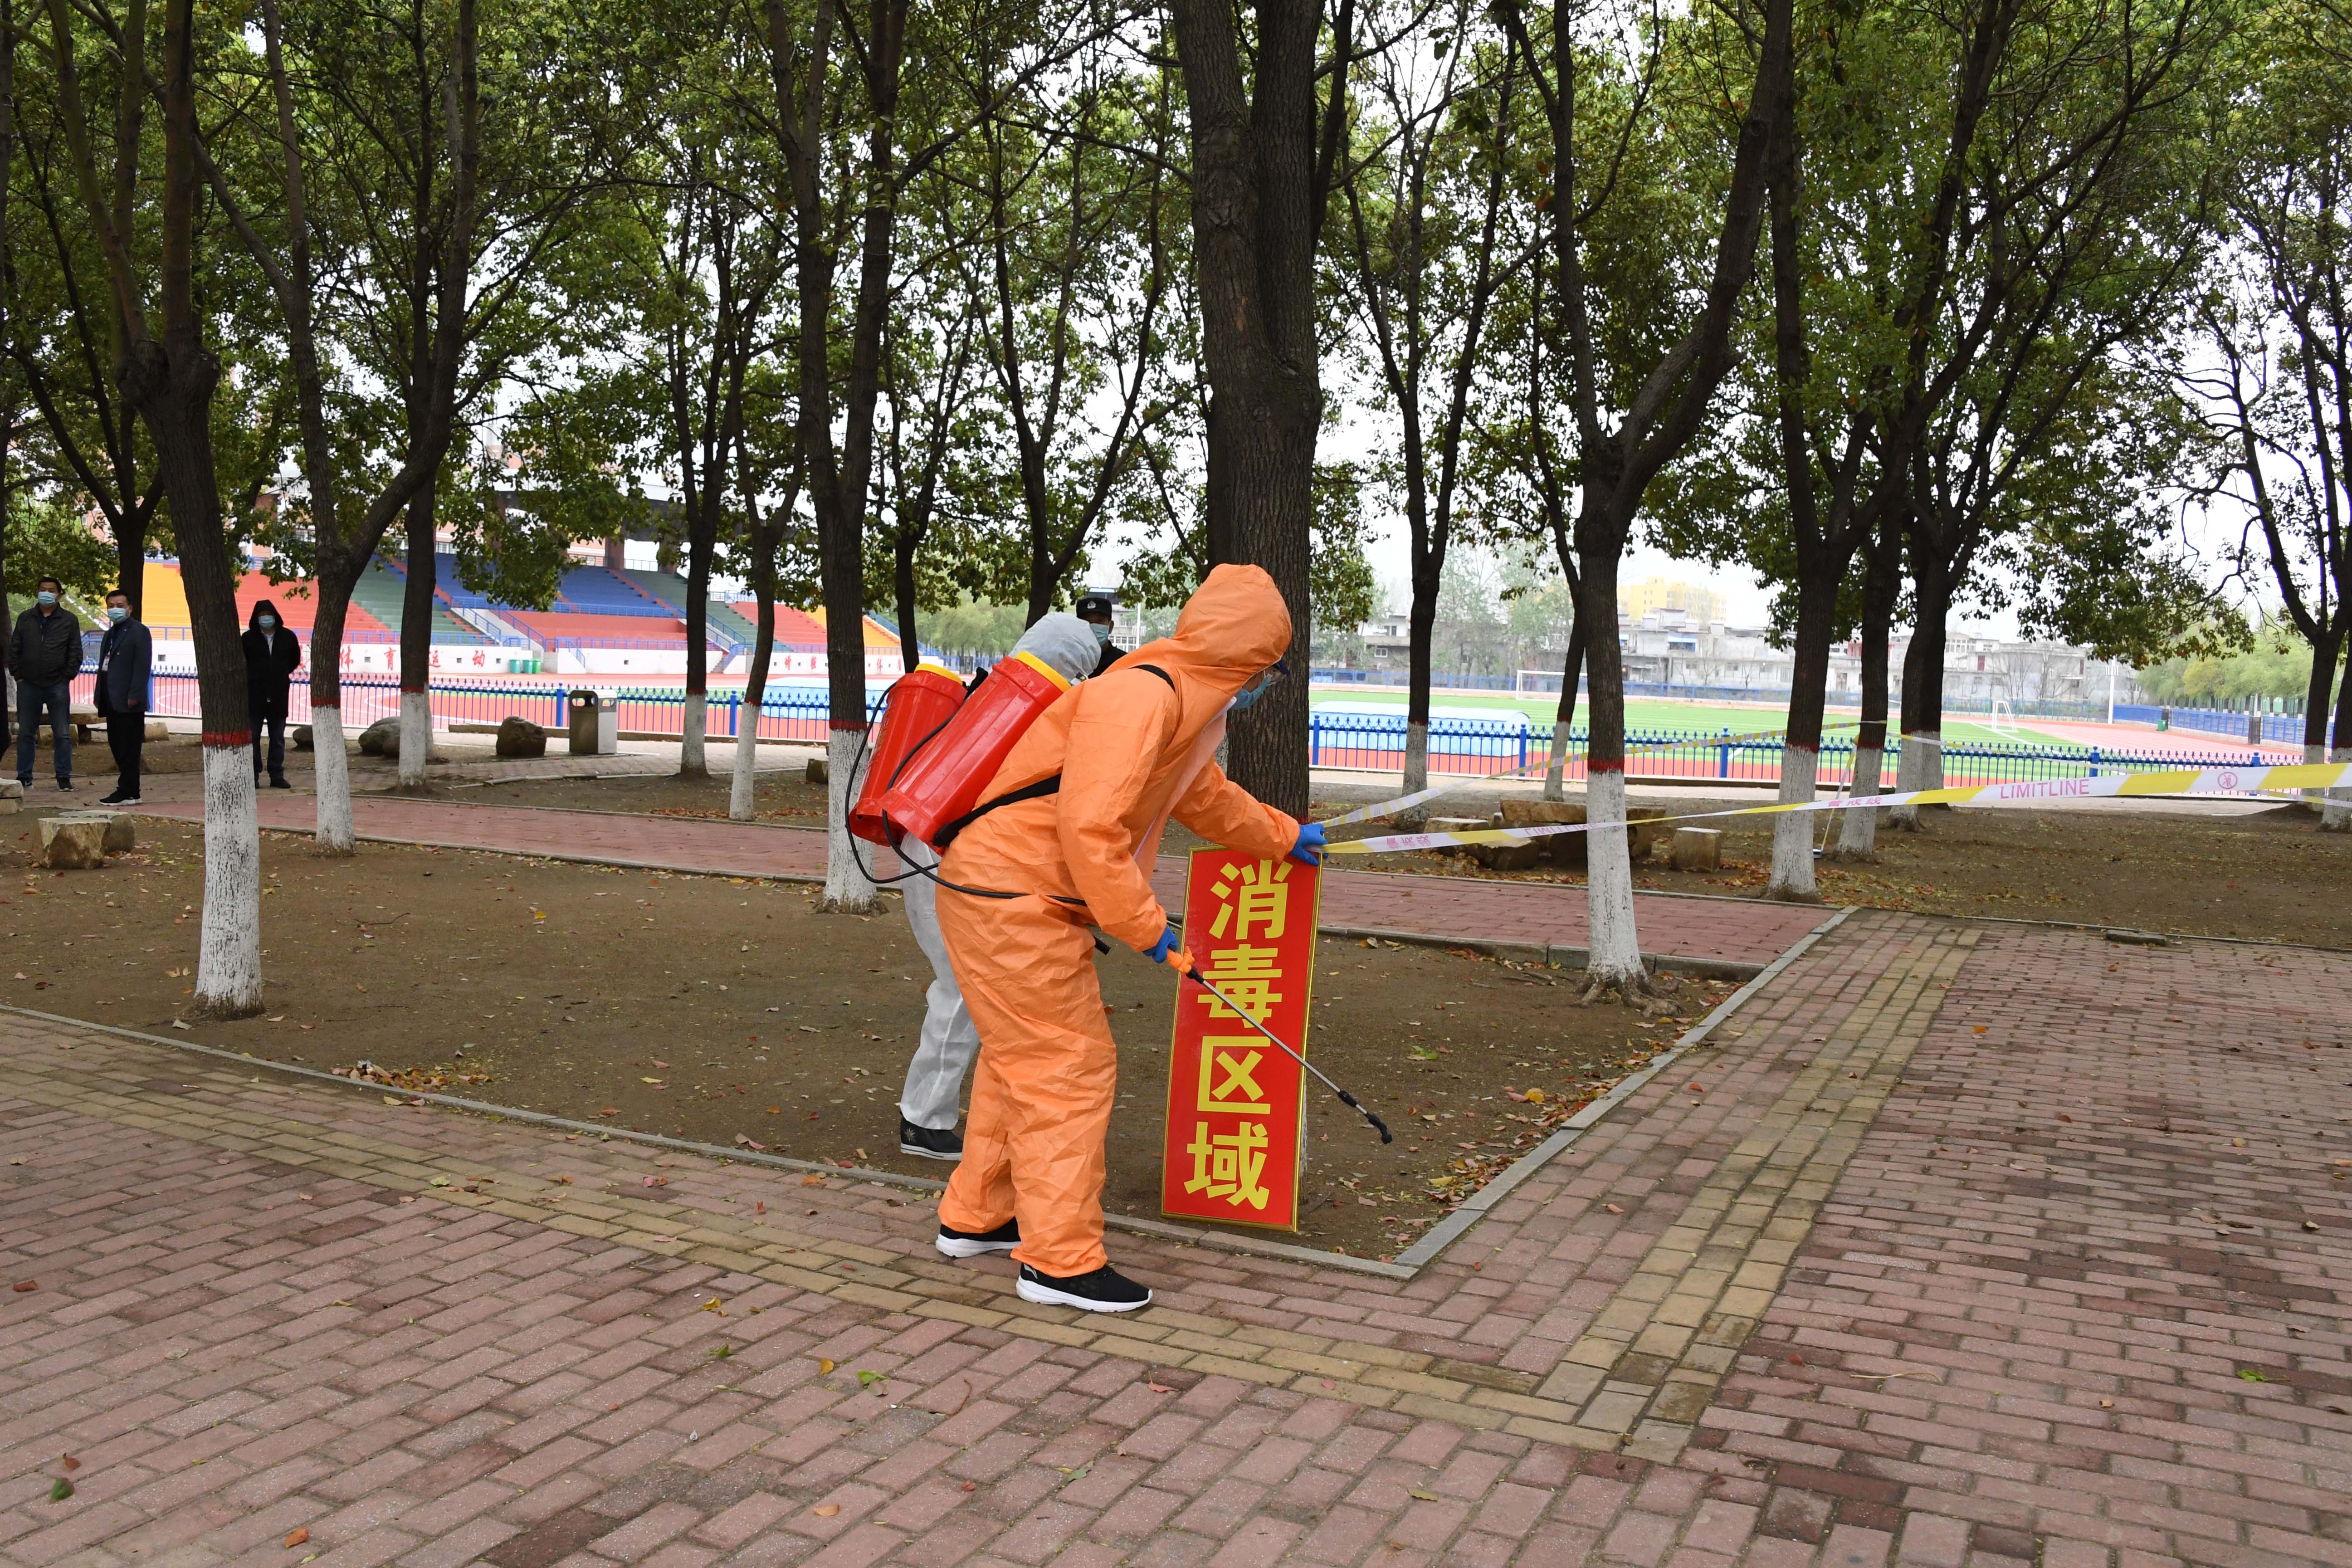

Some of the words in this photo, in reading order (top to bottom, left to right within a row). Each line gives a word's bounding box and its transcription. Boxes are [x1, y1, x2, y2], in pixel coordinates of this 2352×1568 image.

[2000, 779, 2089, 799] LIMITLINE
[1184, 860, 1293, 1210] 消毒区域
